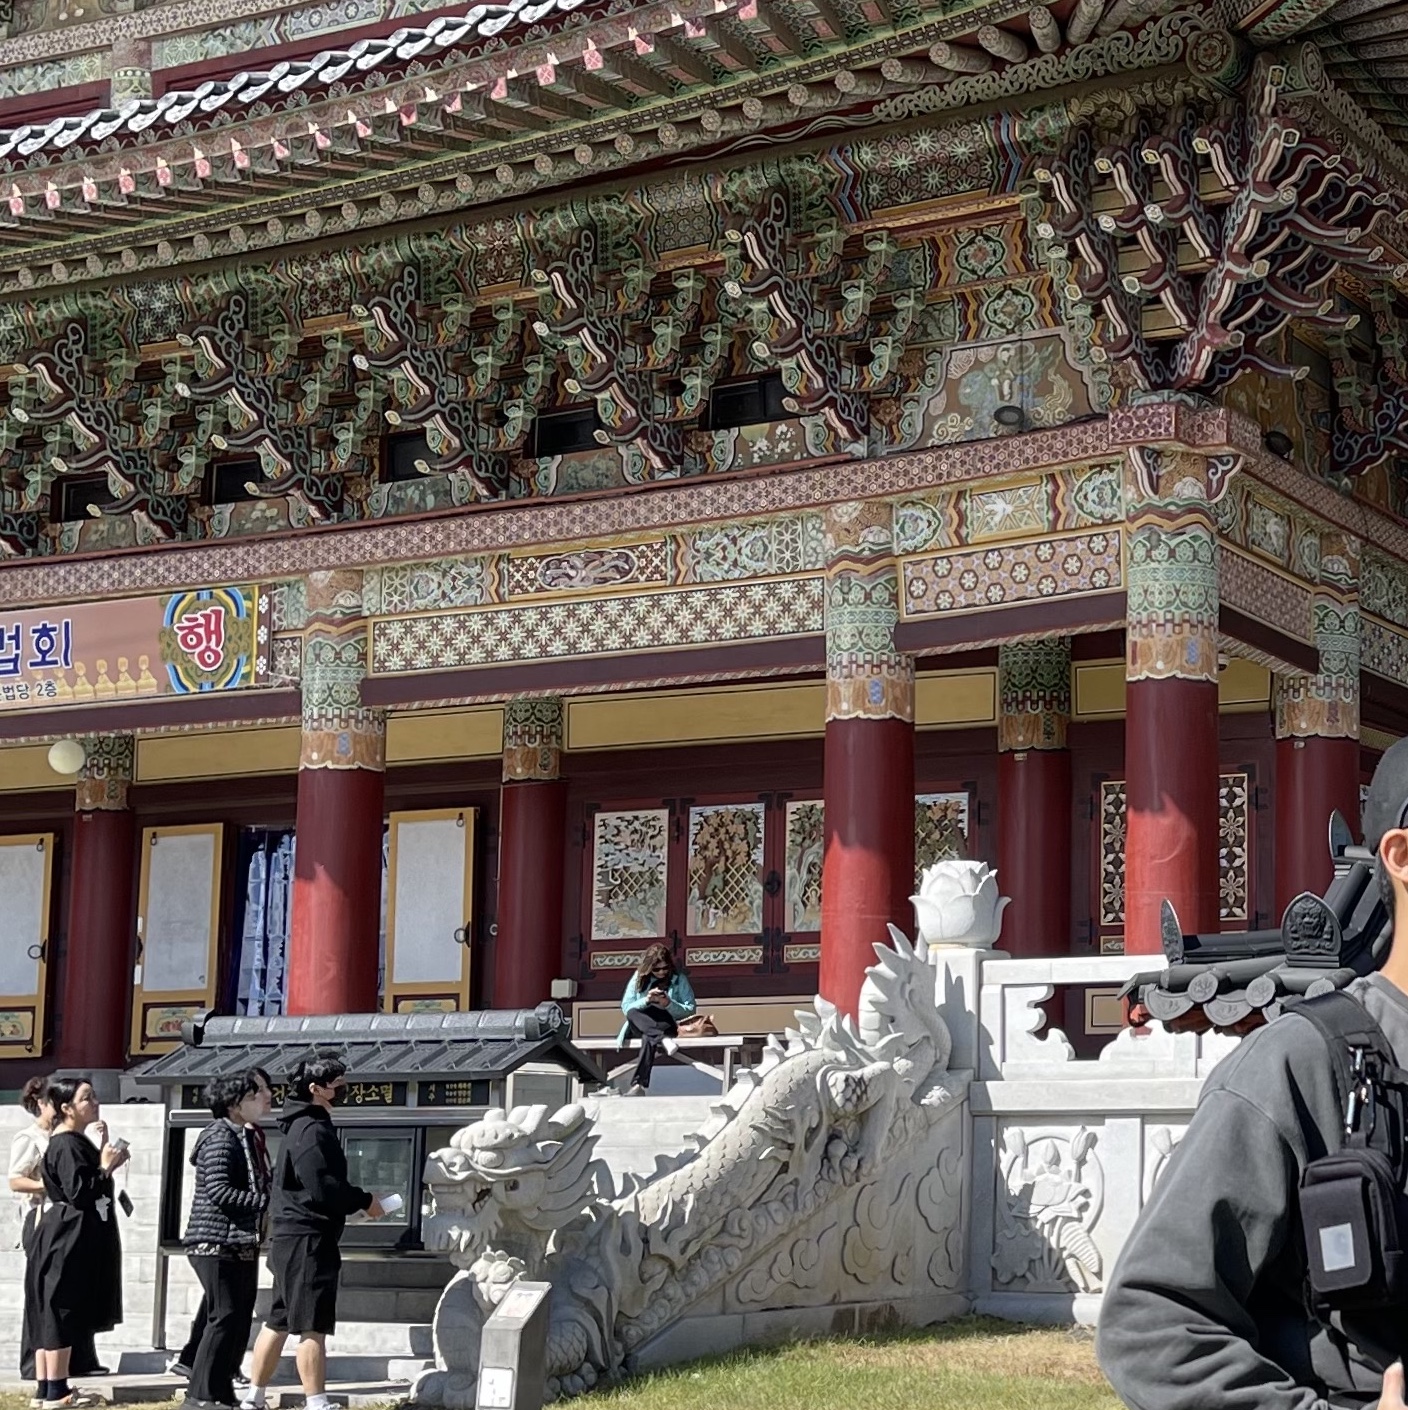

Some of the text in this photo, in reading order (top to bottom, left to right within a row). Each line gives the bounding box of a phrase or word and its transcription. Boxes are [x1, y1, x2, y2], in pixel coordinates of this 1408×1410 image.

[174, 606, 225, 671] 행
[0, 681, 57, 701] 법당 2층
[343, 1083, 393, 1104] 장소멸
